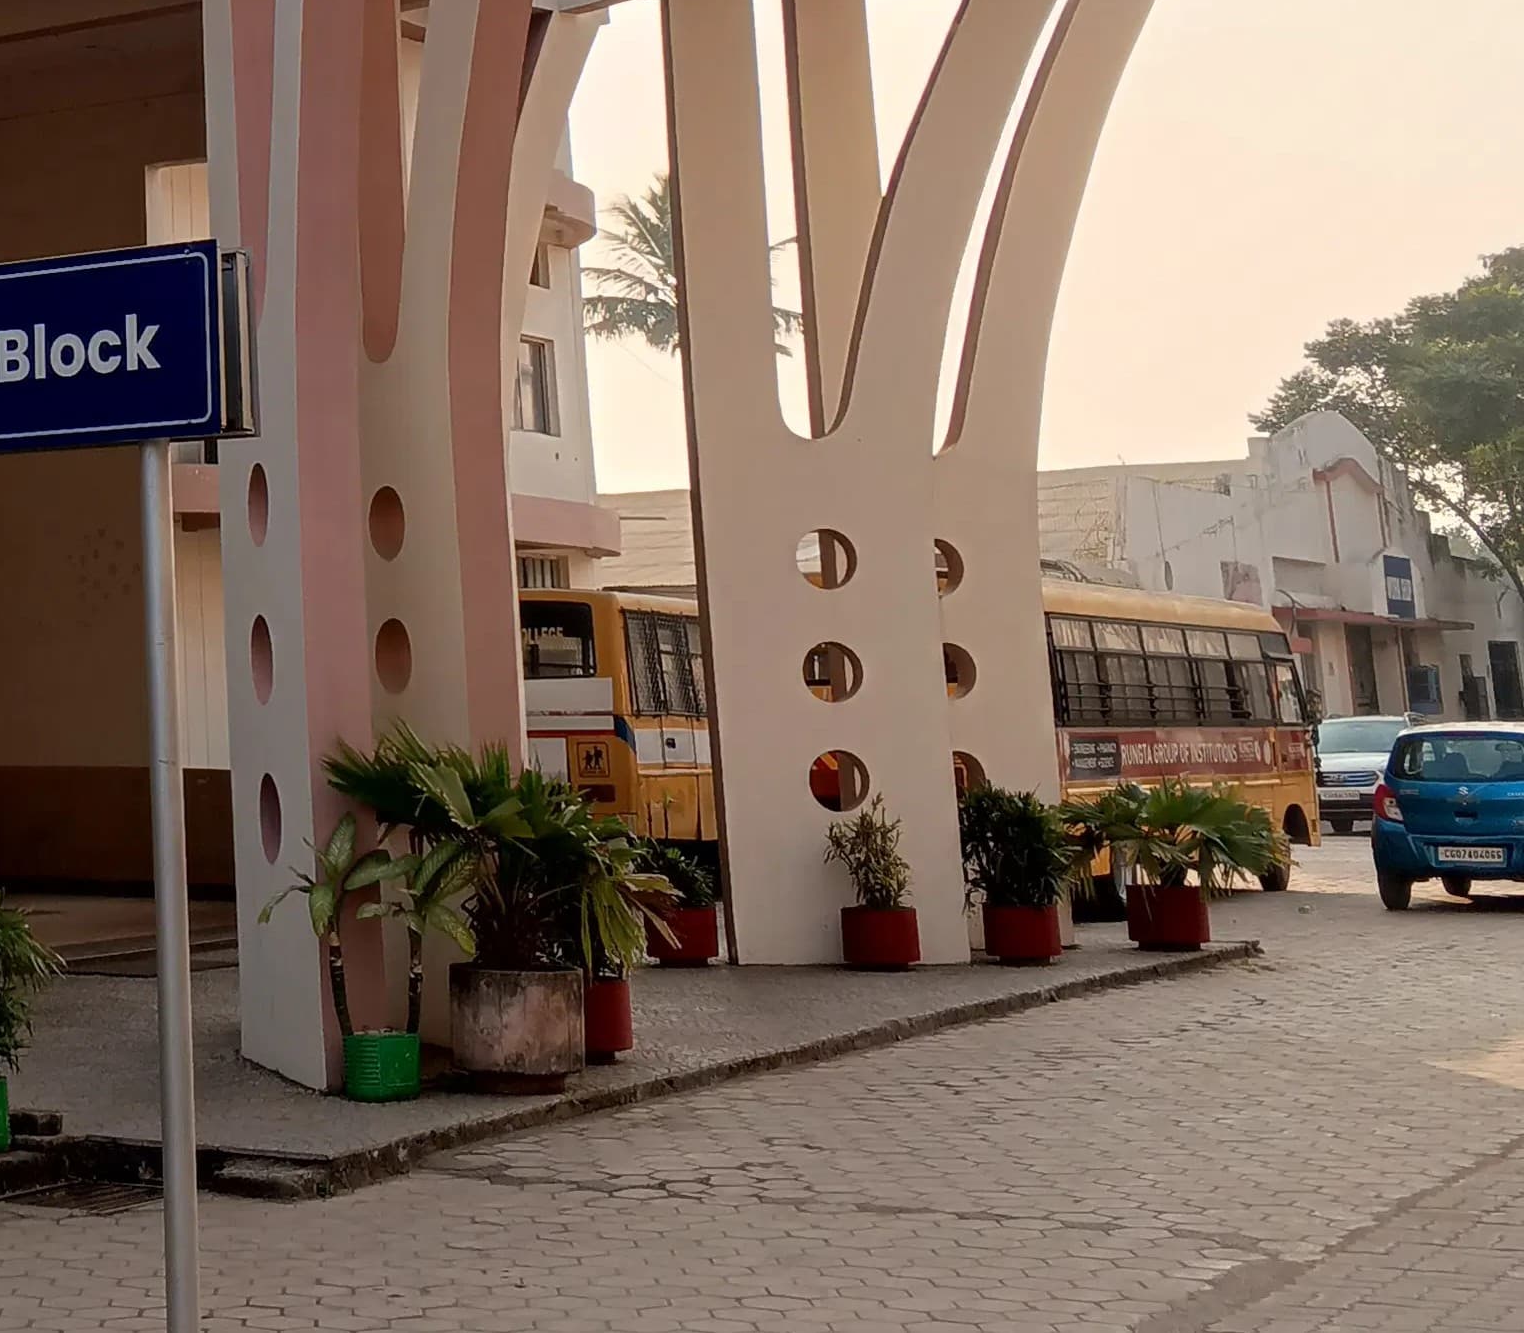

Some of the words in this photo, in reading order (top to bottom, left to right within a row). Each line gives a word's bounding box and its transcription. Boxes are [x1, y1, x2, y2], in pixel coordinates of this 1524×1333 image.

[521, 626, 564, 645] OLLEGE
[1120, 742, 1153, 766] RUNGTA
[1153, 742, 1178, 765] GROUP
[1179, 742, 1190, 763] OF
